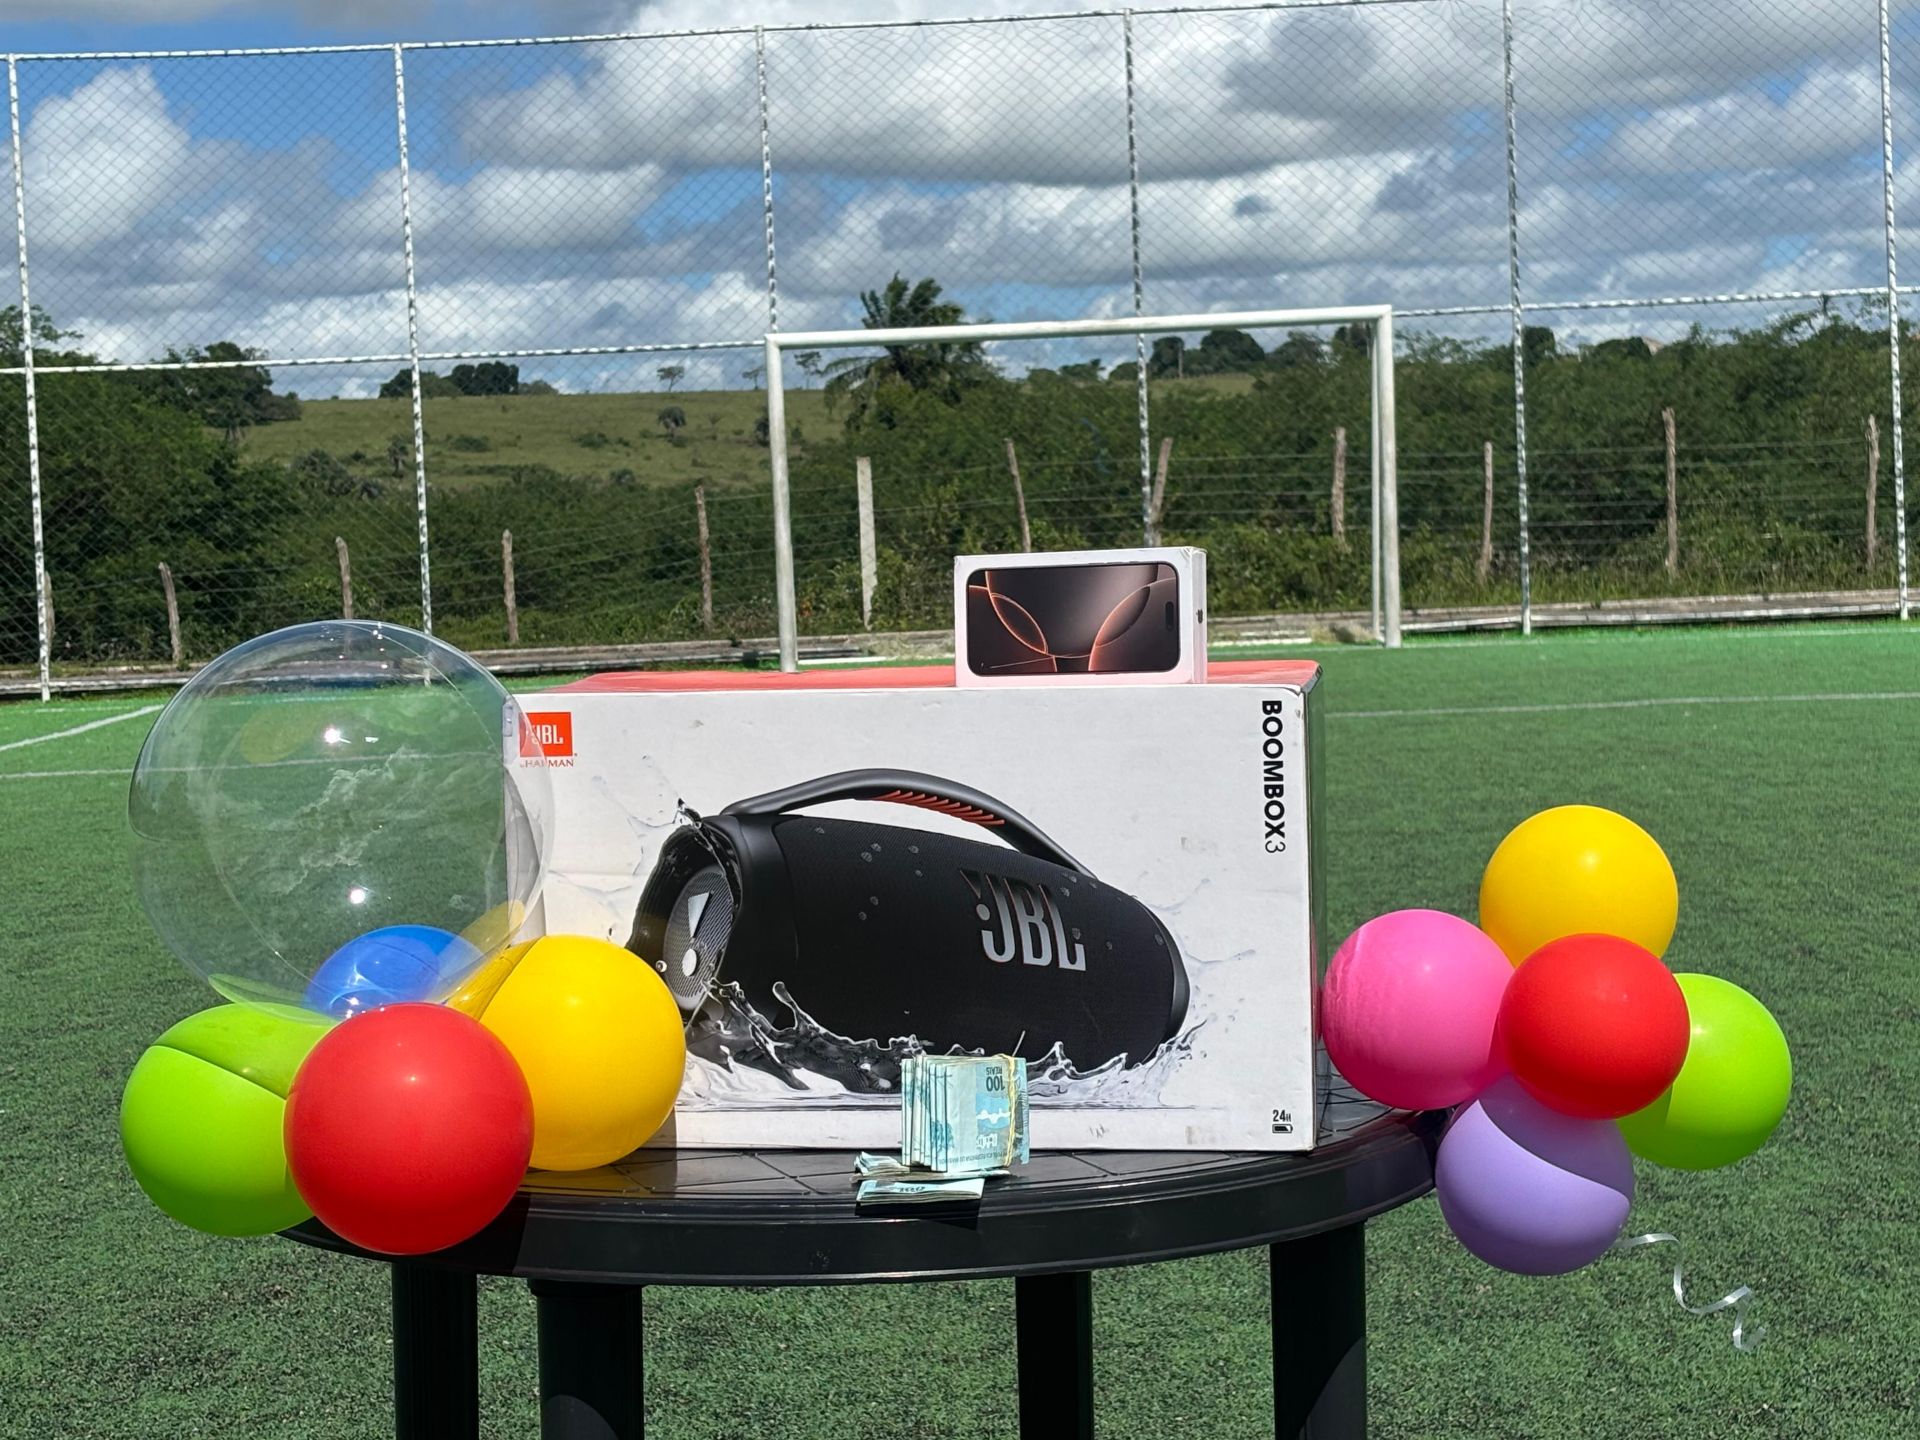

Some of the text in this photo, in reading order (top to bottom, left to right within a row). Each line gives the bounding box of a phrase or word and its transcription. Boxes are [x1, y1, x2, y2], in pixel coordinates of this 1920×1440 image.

[531, 724, 564, 744] JBL
[972, 873, 1086, 971] JBL
[986, 1076, 1005, 1091] 100
